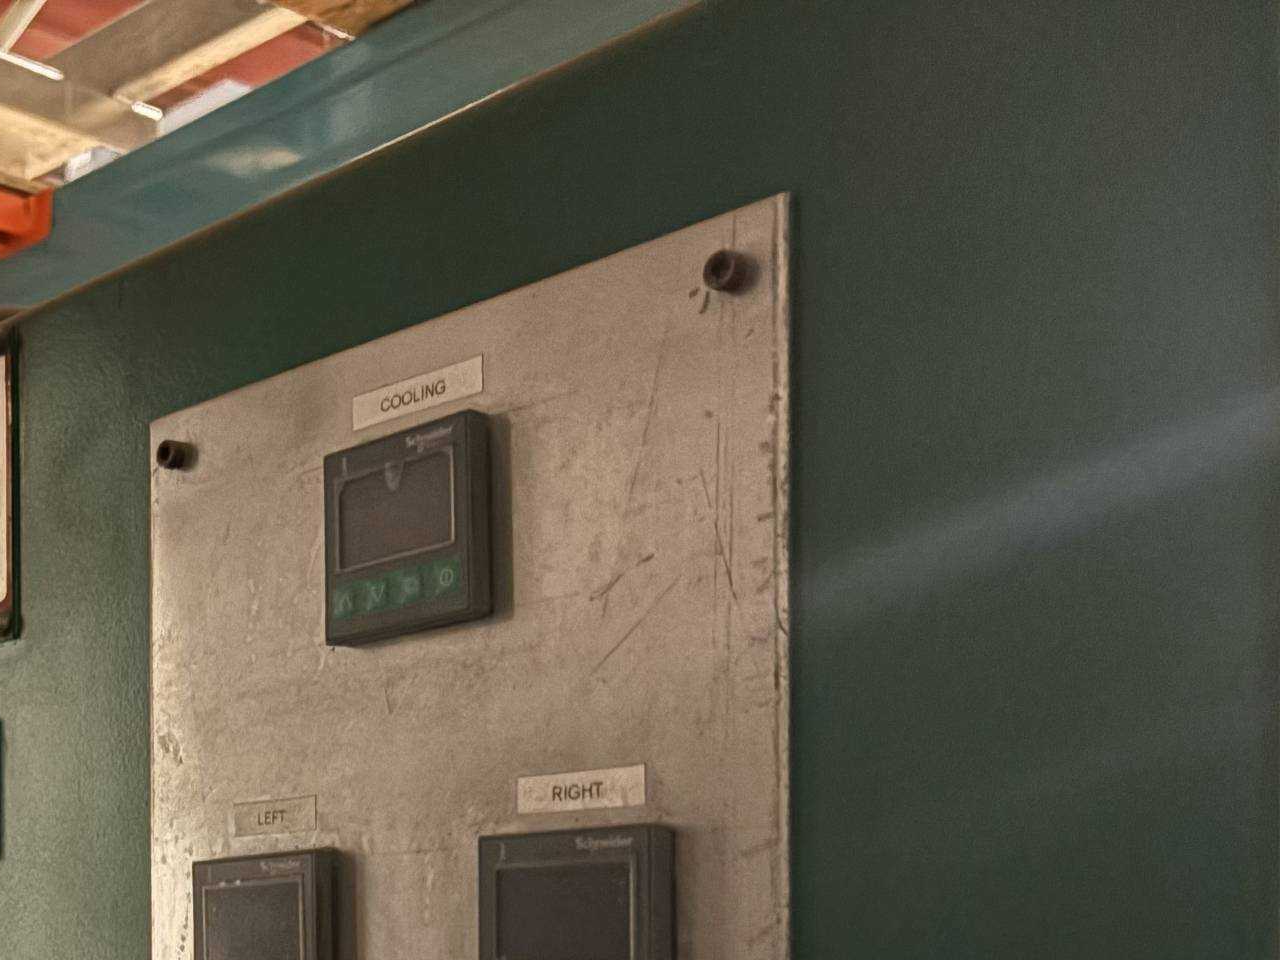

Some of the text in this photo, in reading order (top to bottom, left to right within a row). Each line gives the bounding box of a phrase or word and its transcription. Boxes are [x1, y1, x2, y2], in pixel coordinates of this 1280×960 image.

[380, 380, 447, 412] COOLING
[552, 781, 604, 801] RIGHT
[257, 810, 286, 825] LEFT
